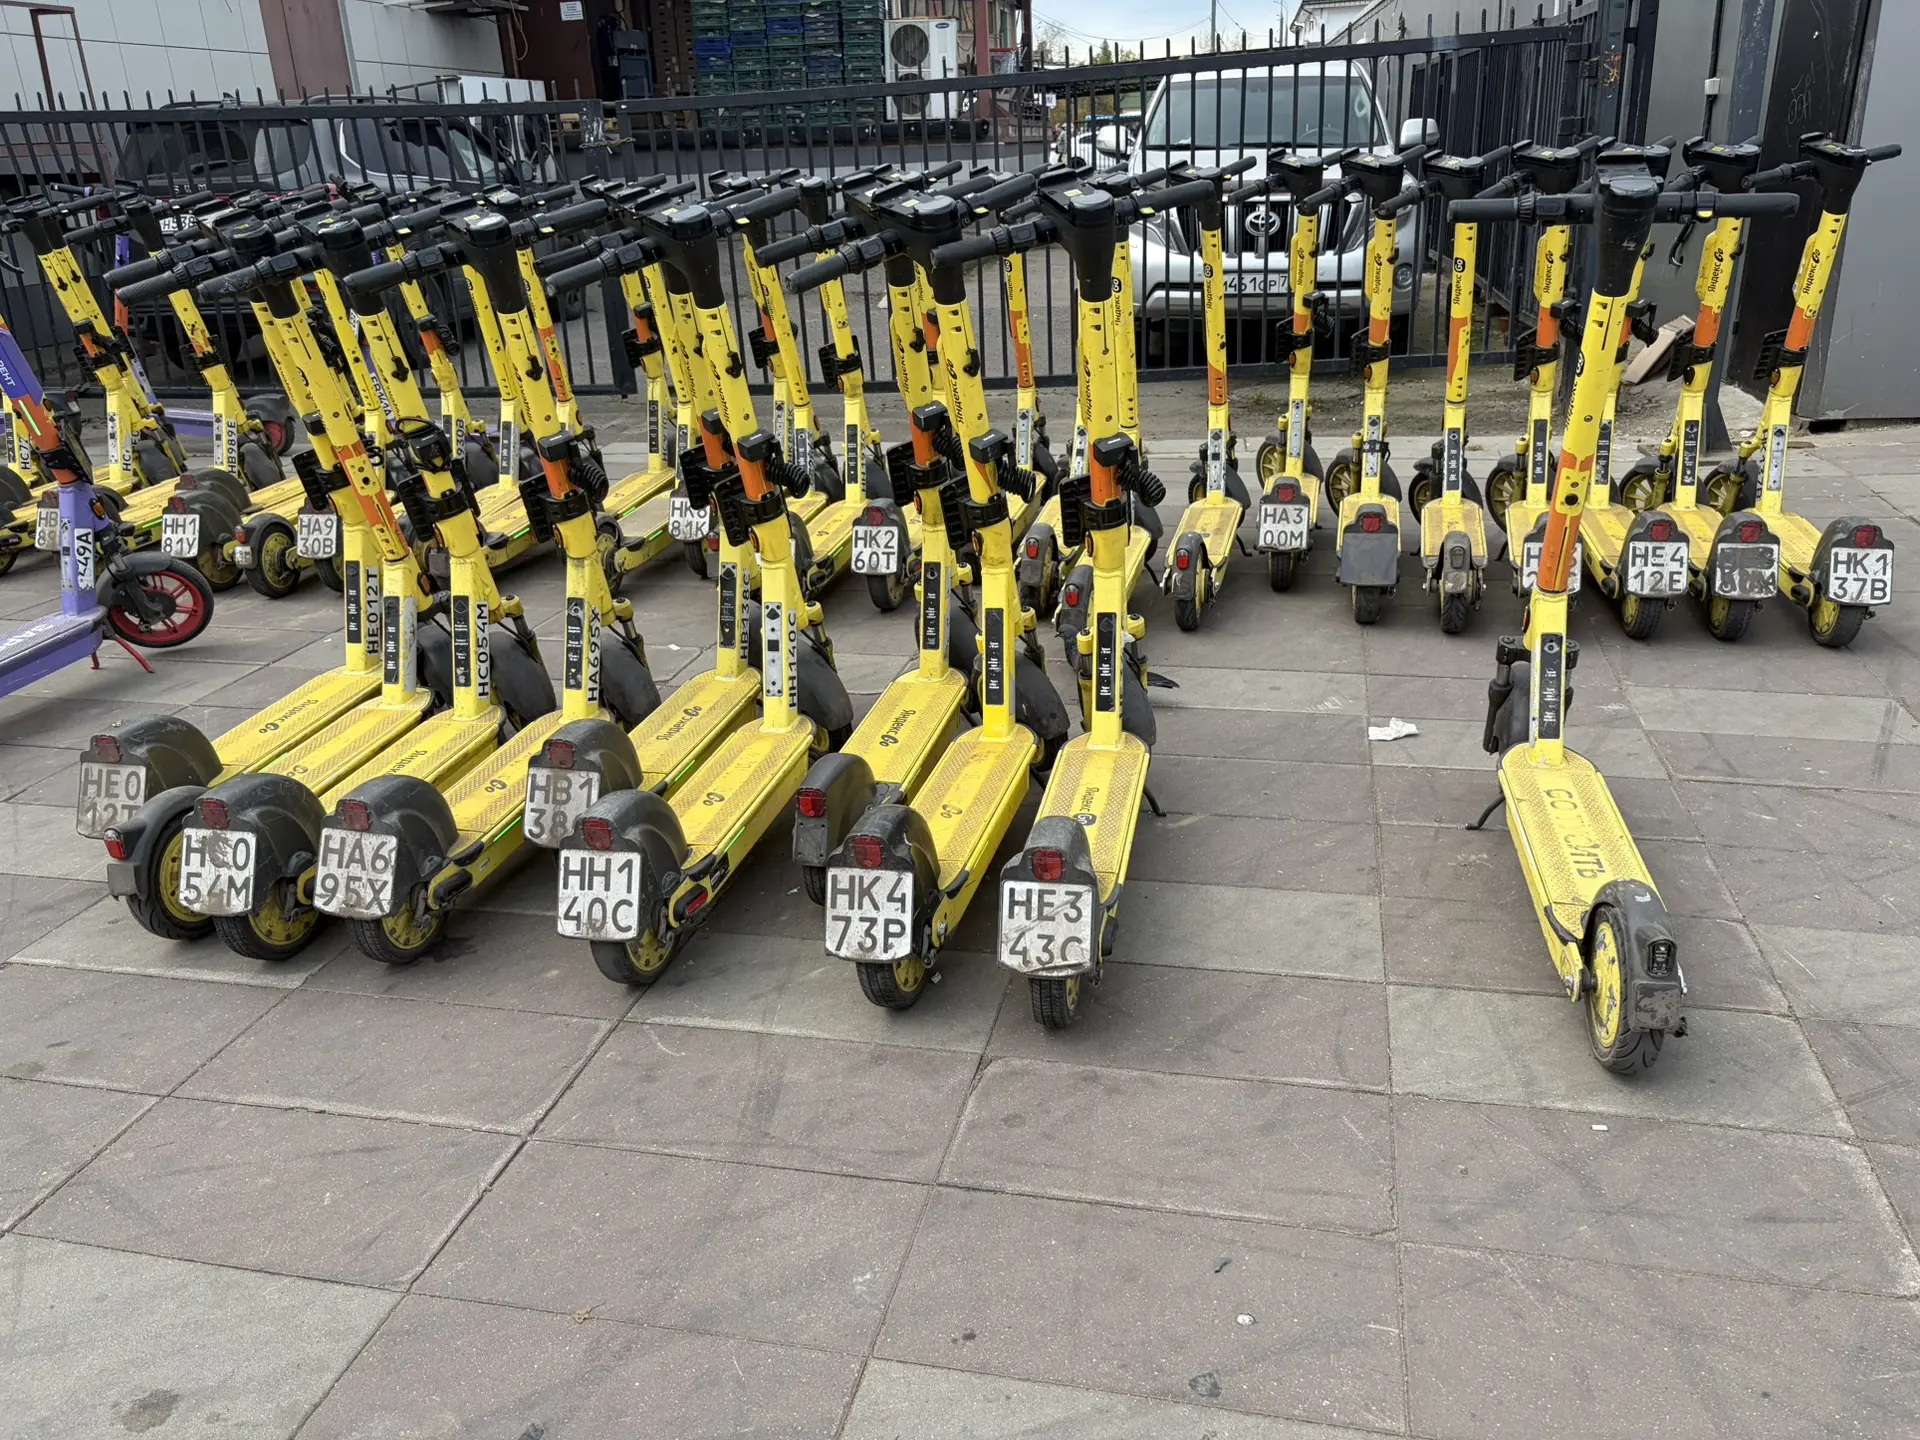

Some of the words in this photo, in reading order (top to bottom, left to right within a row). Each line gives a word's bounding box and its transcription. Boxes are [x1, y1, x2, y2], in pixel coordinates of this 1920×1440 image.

[1453, 274, 1463, 305] Яндекс
[1542, 263, 1554, 294] Яндекс
[1707, 262, 1722, 293] Яндекс
[1802, 263, 1819, 295] Яндекс
[949, 378, 964, 424] Яндекс
[163, 518, 197, 536] HH1
[299, 518, 335, 536] HA9
[670, 520, 708, 539] 81K
[1263, 508, 1304, 525] HA3
[162, 538, 197, 555] 81Y
[299, 538, 335, 556] 30B
[854, 529, 896, 549] HK2
[854, 551, 897, 572] 60T
[1631, 546, 1686, 568] HE4
[1832, 551, 1889, 575] HK1
[1632, 571, 1683, 592] 12E
[1831, 577, 1888, 601] 37B
[366, 570, 379, 655] HE012T
[476, 603, 489, 697] HC054M
[588, 606, 600, 702] HA695X
[788, 612, 797, 708] HH140C
[655, 713, 689, 742] Яндекс
[683, 705, 703, 720] Go
[81, 768, 142, 800] HE0
[530, 773, 594, 806] HB1
[528, 808, 575, 840] 38
[321, 836, 389, 874] HA6
[563, 856, 634, 892] HH1
[320, 873, 388, 912] 95X
[830, 876, 906, 913] HK4
[1008, 888, 1084, 923] HE3
[562, 897, 634, 933] 40C
[830, 915, 906, 953] 73P
[1008, 933, 1083, 967] 43C
